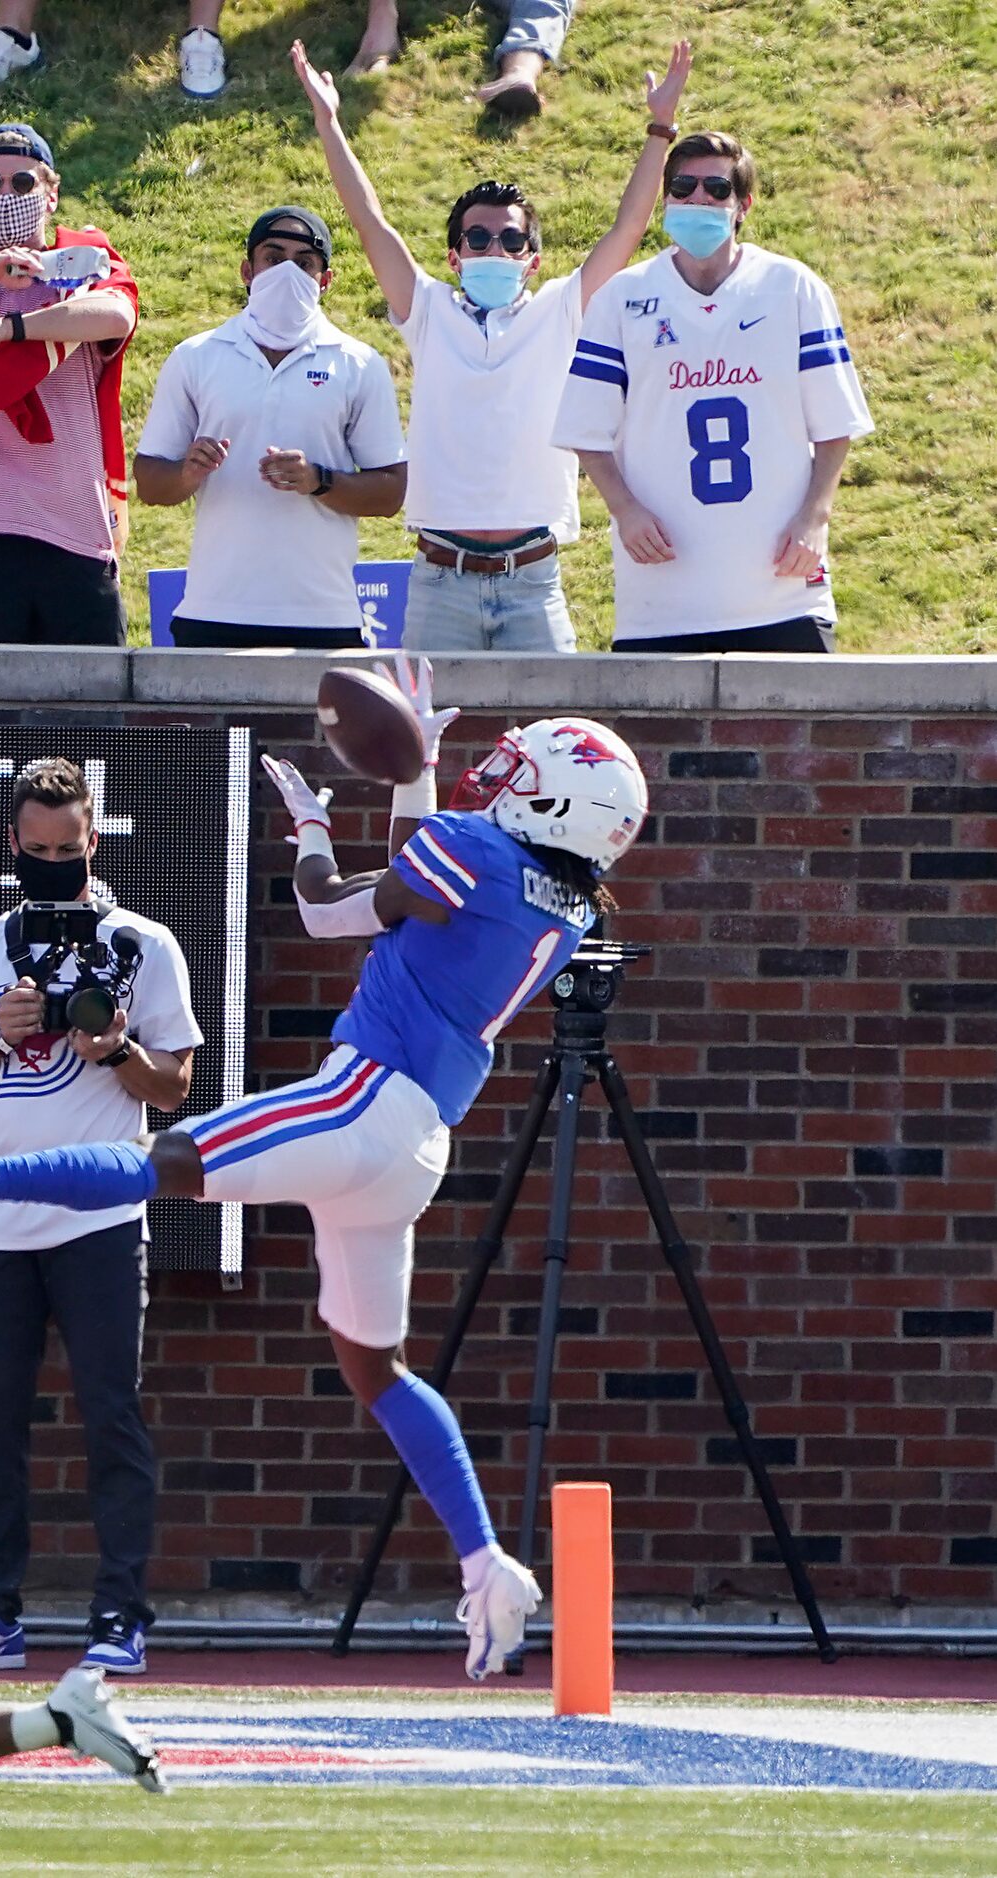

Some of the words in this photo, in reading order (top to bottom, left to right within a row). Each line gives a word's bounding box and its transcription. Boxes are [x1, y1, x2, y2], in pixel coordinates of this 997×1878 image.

[306, 370, 330, 381] SMU
[668, 358, 763, 390] Dallas
[686, 396, 753, 505] 8
[356, 582, 389, 598] CING
[480, 927, 561, 1044] 1
